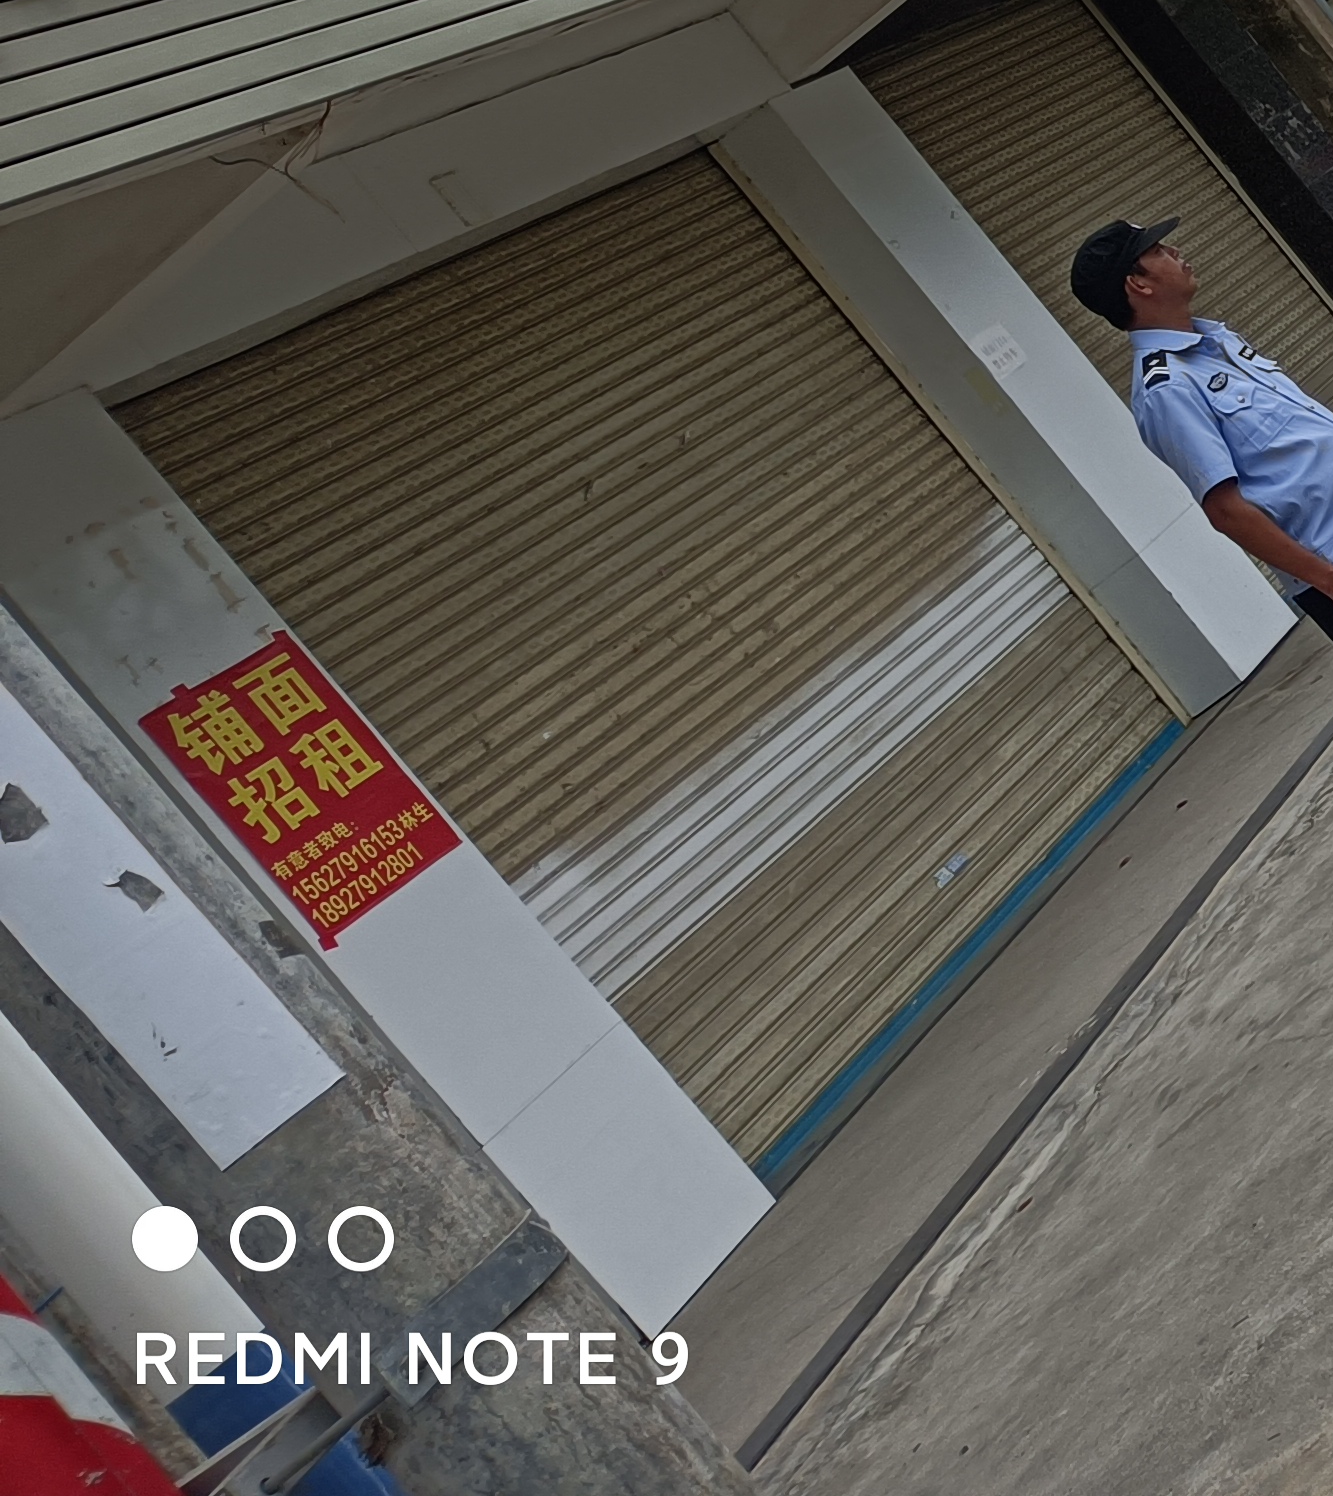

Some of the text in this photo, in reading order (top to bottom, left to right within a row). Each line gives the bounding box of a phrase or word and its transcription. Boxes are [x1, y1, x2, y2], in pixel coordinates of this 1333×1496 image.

[167, 651, 327, 776] 铺面
[227, 717, 384, 845] 招租
[311, 840, 424, 929] 18927912801
